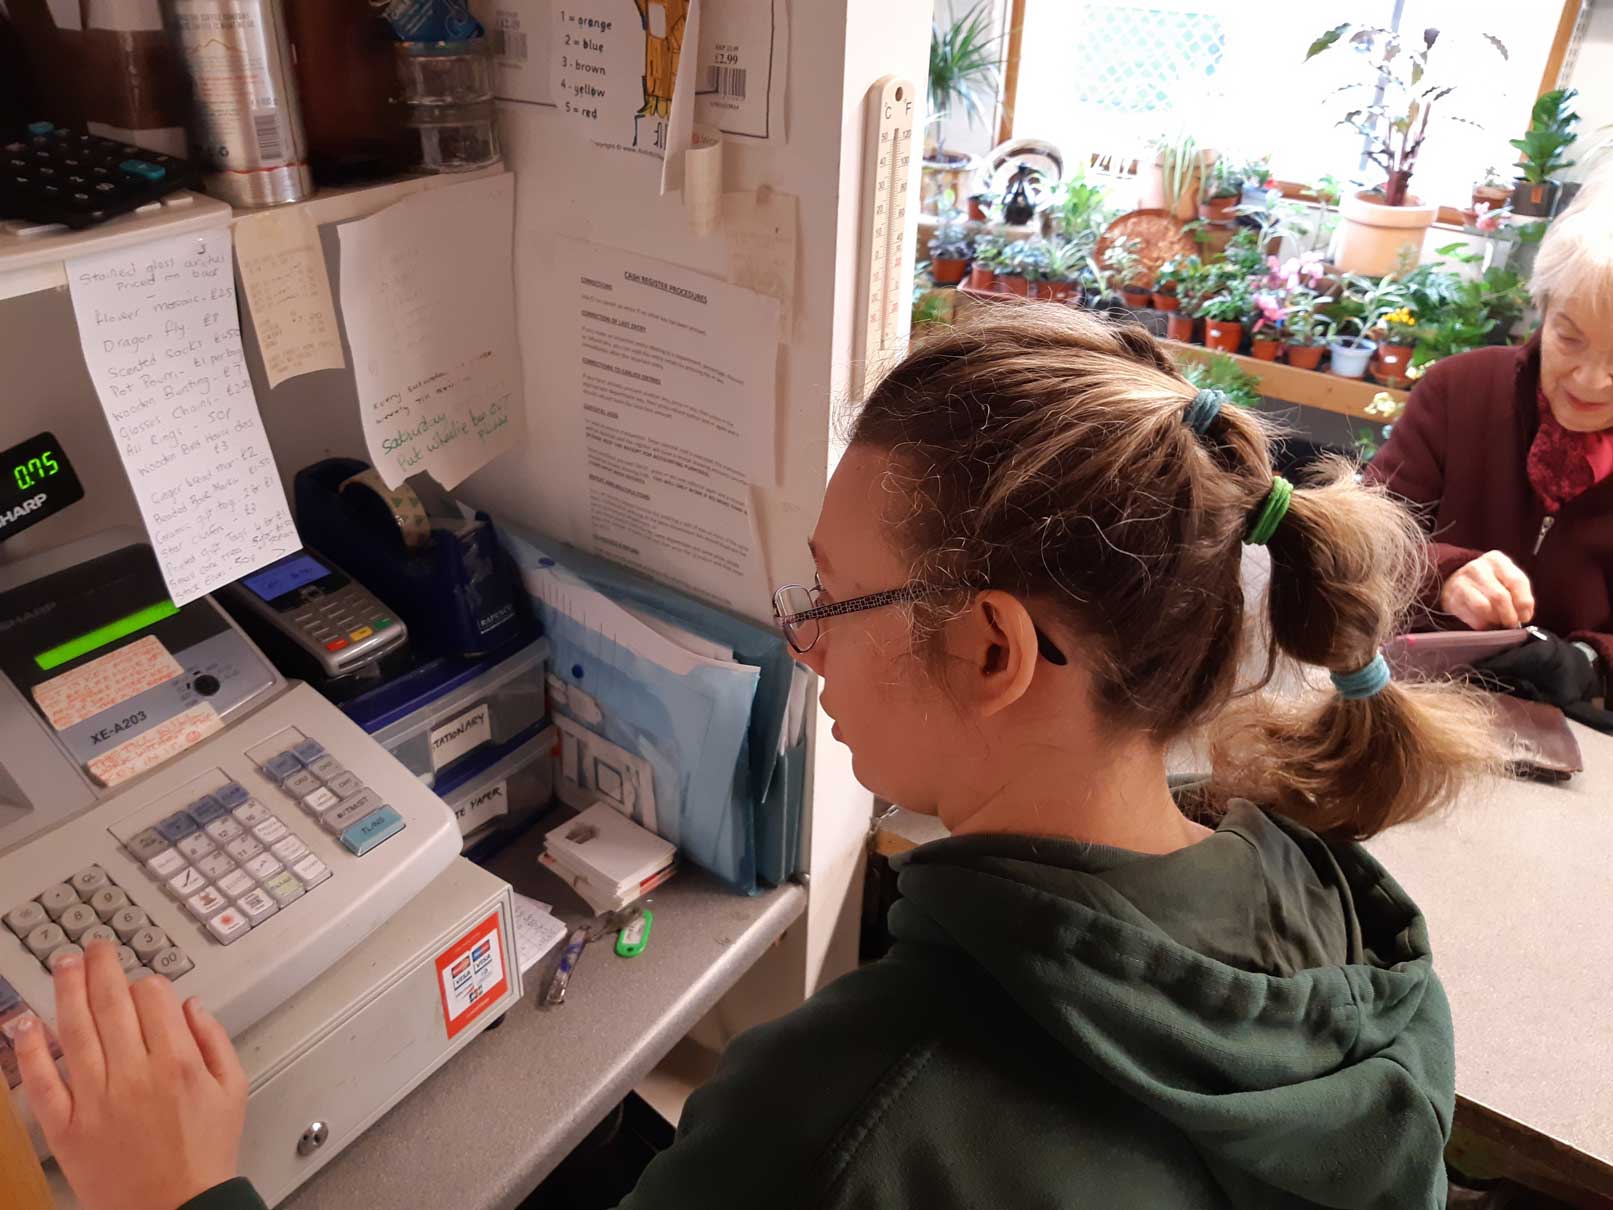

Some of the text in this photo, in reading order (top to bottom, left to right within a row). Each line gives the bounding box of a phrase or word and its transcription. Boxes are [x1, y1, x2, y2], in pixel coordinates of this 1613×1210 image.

[561, 11, 565, 22] 1
[578, 16, 612, 32] orange
[565, 34, 571, 46] 2
[583, 38, 604, 53] blue
[562, 56, 567, 67] 3
[575, 60, 606, 75] brown
[561, 79, 566, 89] 4
[574, 83, 605, 97] yellow
[565, 102, 571, 112] 5
[582, 108, 598, 120] red
[902, 129, 912, 140] 120
[880, 156, 887, 167] 40
[624, 271, 707, 304] CASH REGISTER PROCEDURES
[103, 334, 152, 352] Dragon
[14, 451, 59, 490] 0.75
[0, 493, 47, 528] HARP
[90, 710, 148, 745] XE-A203
[219, 830, 228, 839] 12
[103, 892, 113, 903] 9
[74, 911, 82, 921] 8
[124, 912, 133, 922] 6
[40, 930, 49, 940] 7
[144, 933, 153, 944] 3
[161, 951, 177, 967] 00
[475, 953, 491, 968] VISA
[455, 970, 471, 985] VISA
